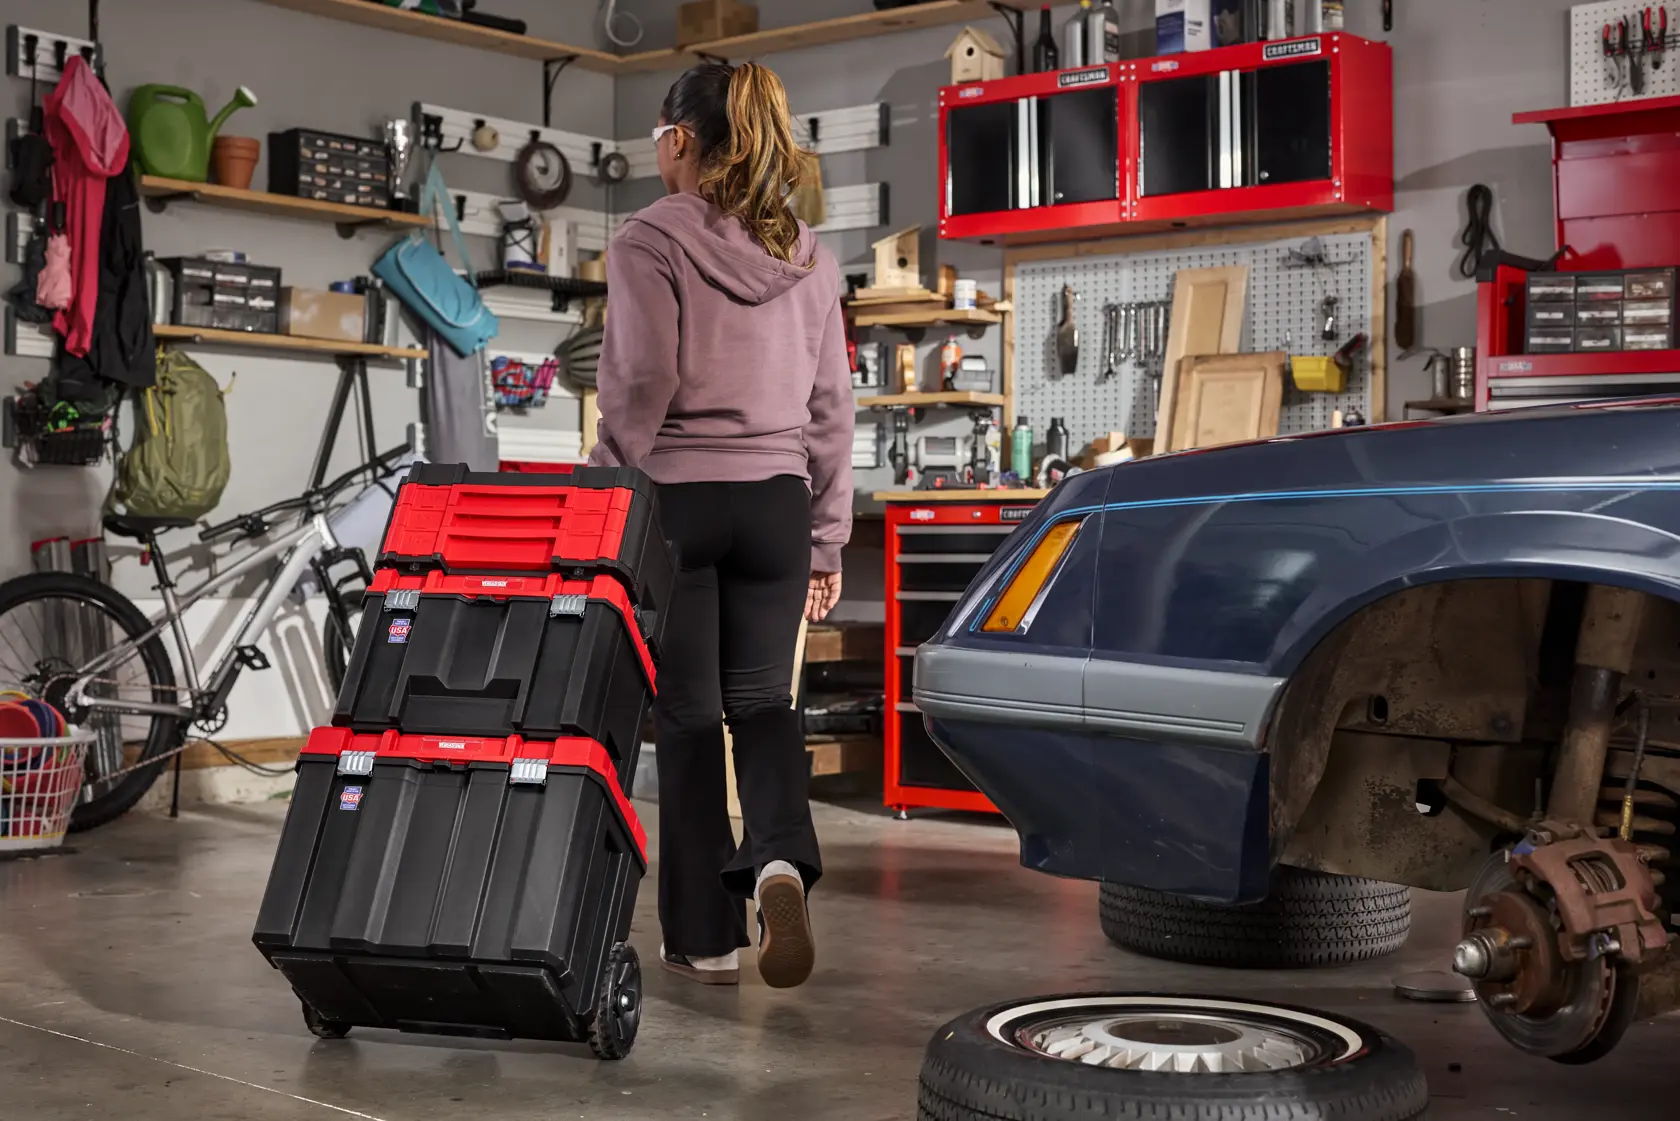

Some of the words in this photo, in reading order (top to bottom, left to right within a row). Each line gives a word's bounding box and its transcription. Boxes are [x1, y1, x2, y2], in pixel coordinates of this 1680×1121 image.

[1266, 40, 1317, 57] CRAFTSMAN
[1061, 69, 1106, 84] CRAFTSMAN
[390, 626, 408, 634] USA
[342, 794, 359, 802] USA
